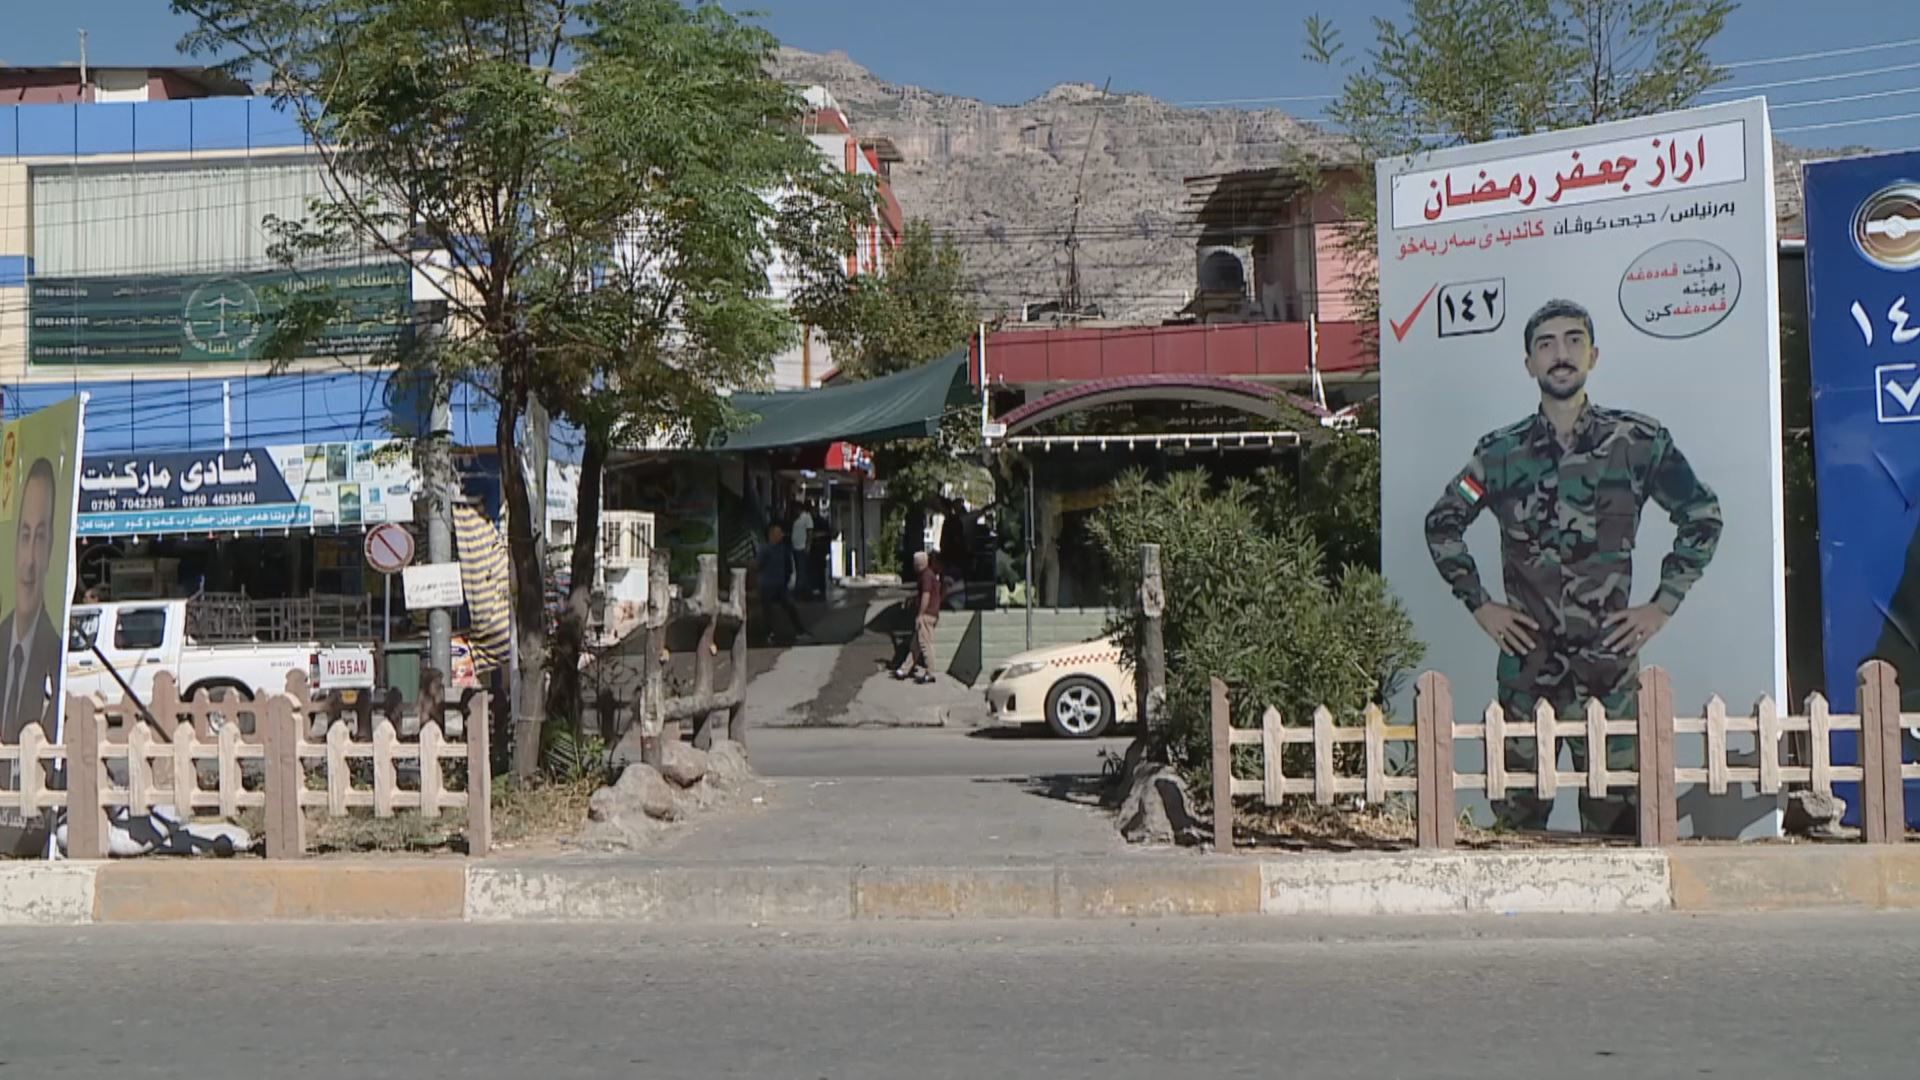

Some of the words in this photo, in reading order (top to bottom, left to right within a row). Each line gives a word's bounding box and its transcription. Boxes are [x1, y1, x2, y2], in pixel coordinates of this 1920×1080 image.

[1545, 150, 1637, 202] جعفر
[1645, 133, 1706, 187] اراز
[1423, 168, 1537, 220] رمضان
[1445, 287, 1498, 325] ١٤٢
[180, 451, 257, 493] شادی
[91, 499, 116, 511] 0750
[182, 494, 207, 507] 0750
[327, 659, 367, 675] NISSAN
